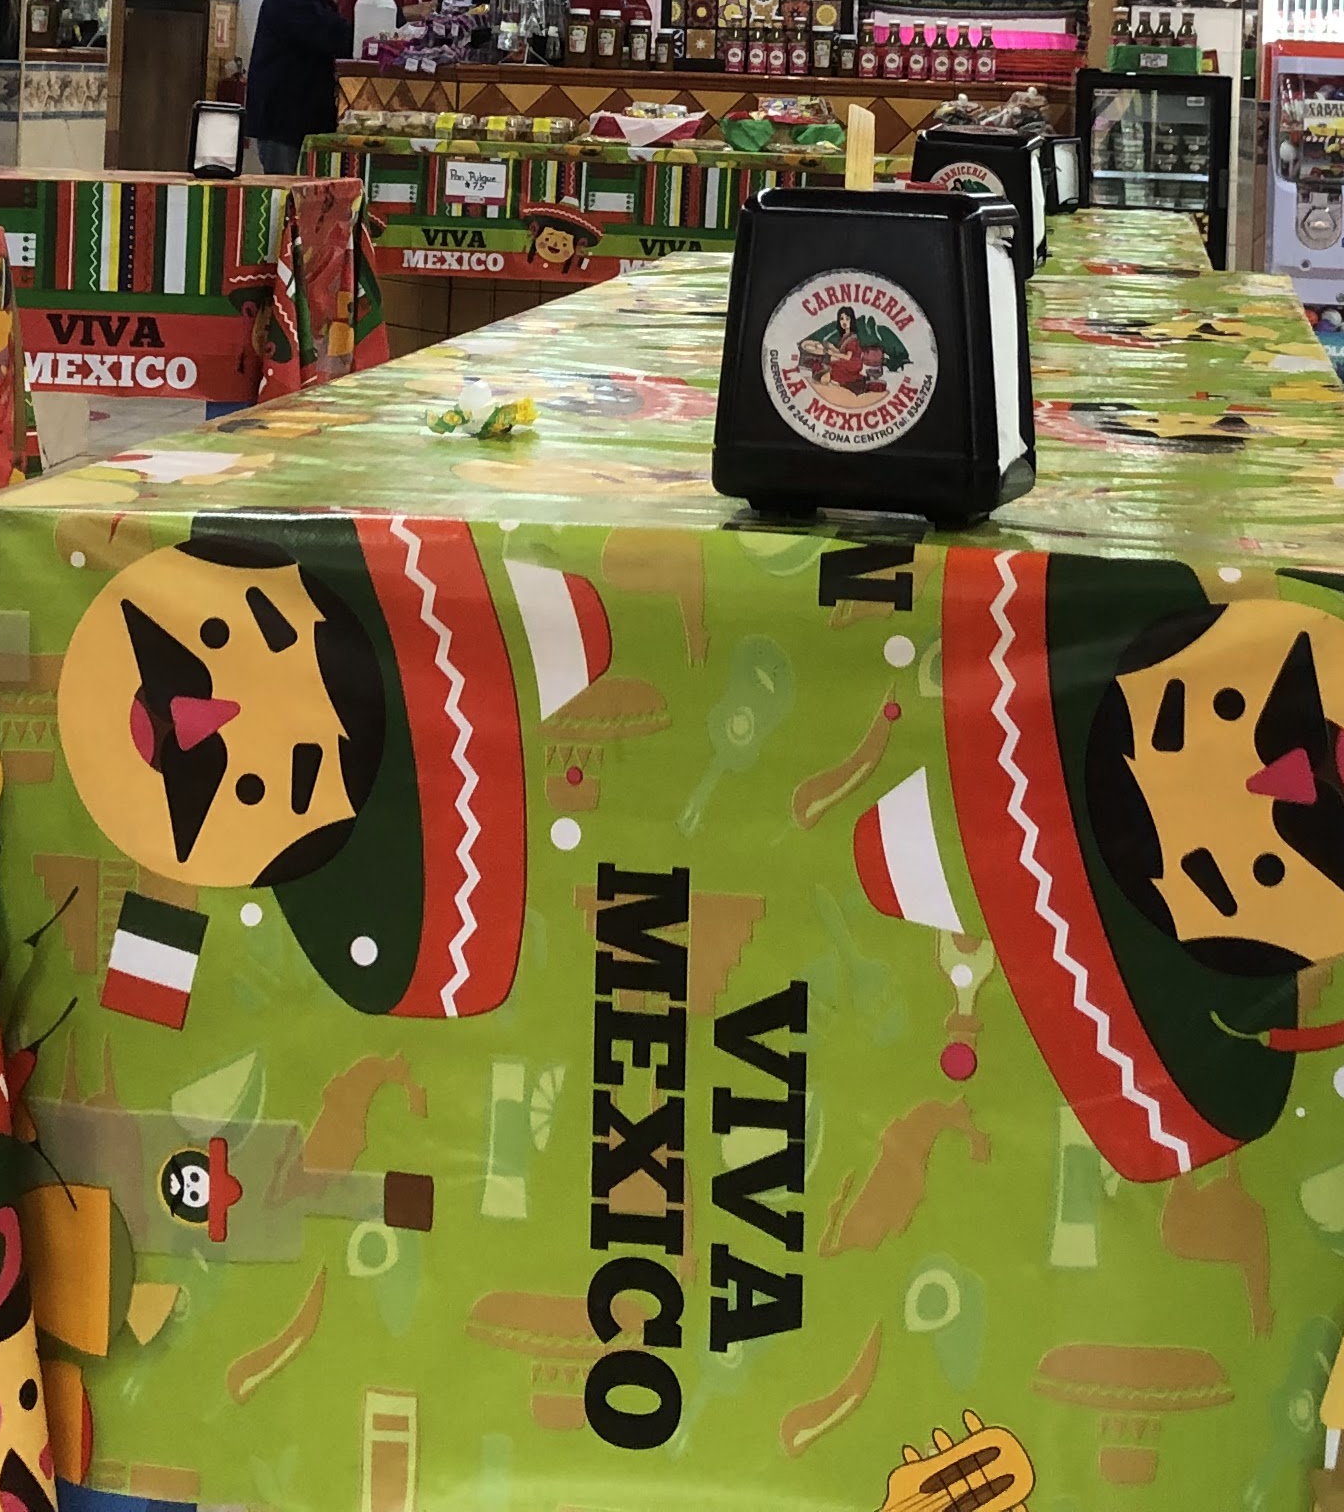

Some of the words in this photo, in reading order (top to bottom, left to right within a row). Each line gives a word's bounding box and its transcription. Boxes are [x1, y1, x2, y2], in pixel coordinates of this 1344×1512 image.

[422, 228, 487, 249] VIVA
[639, 238, 704, 256] VIVA
[402, 249, 505, 272] MEXICO
[801, 283, 915, 332] CARNICERIA
[46, 313, 165, 348] VIVA
[24, 351, 198, 390] MEXICO
[769, 349, 791, 405] GUERRERO
[821, 429, 851, 444] ZONA
[854, 427, 894, 444] CENTRO
[584, 862, 692, 1451] MEXICO
[710, 980, 808, 1353] VIVA
